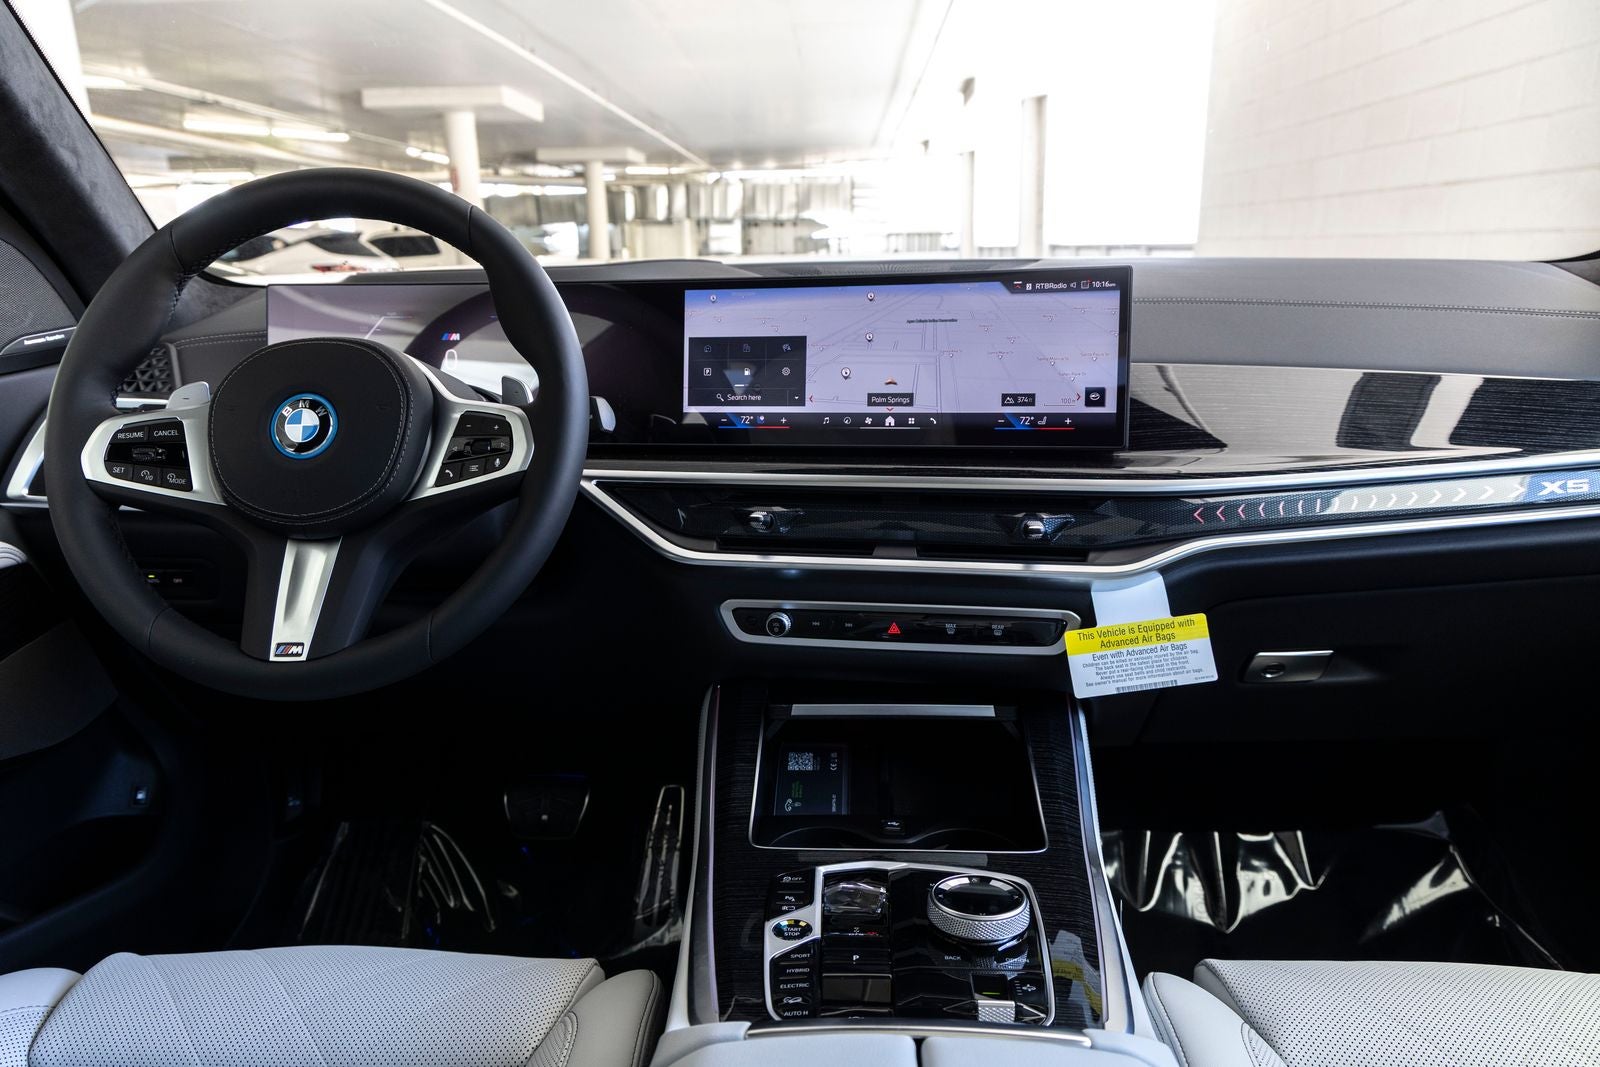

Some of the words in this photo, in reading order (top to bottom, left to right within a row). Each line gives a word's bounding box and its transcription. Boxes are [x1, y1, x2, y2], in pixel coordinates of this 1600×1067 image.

[282, 400, 328, 417] BMW
[888, 396, 910, 404] Springs
[118, 432, 144, 440] RESUME
[154, 429, 180, 437] CANCEL
[1537, 479, 1590, 496] X5
[1078, 631, 1094, 641] This
[1097, 627, 1126, 638] Vehicle
[1128, 626, 1135, 634] is
[1138, 620, 1175, 635] Equipped
[1178, 618, 1194, 627] with
[1100, 636, 1139, 648] Advanced
[1142, 634, 1152, 642] Air
[1156, 631, 1175, 642] Bags
[1126, 646, 1158, 656] Advanced
[1171, 642, 1187, 651] Bags
